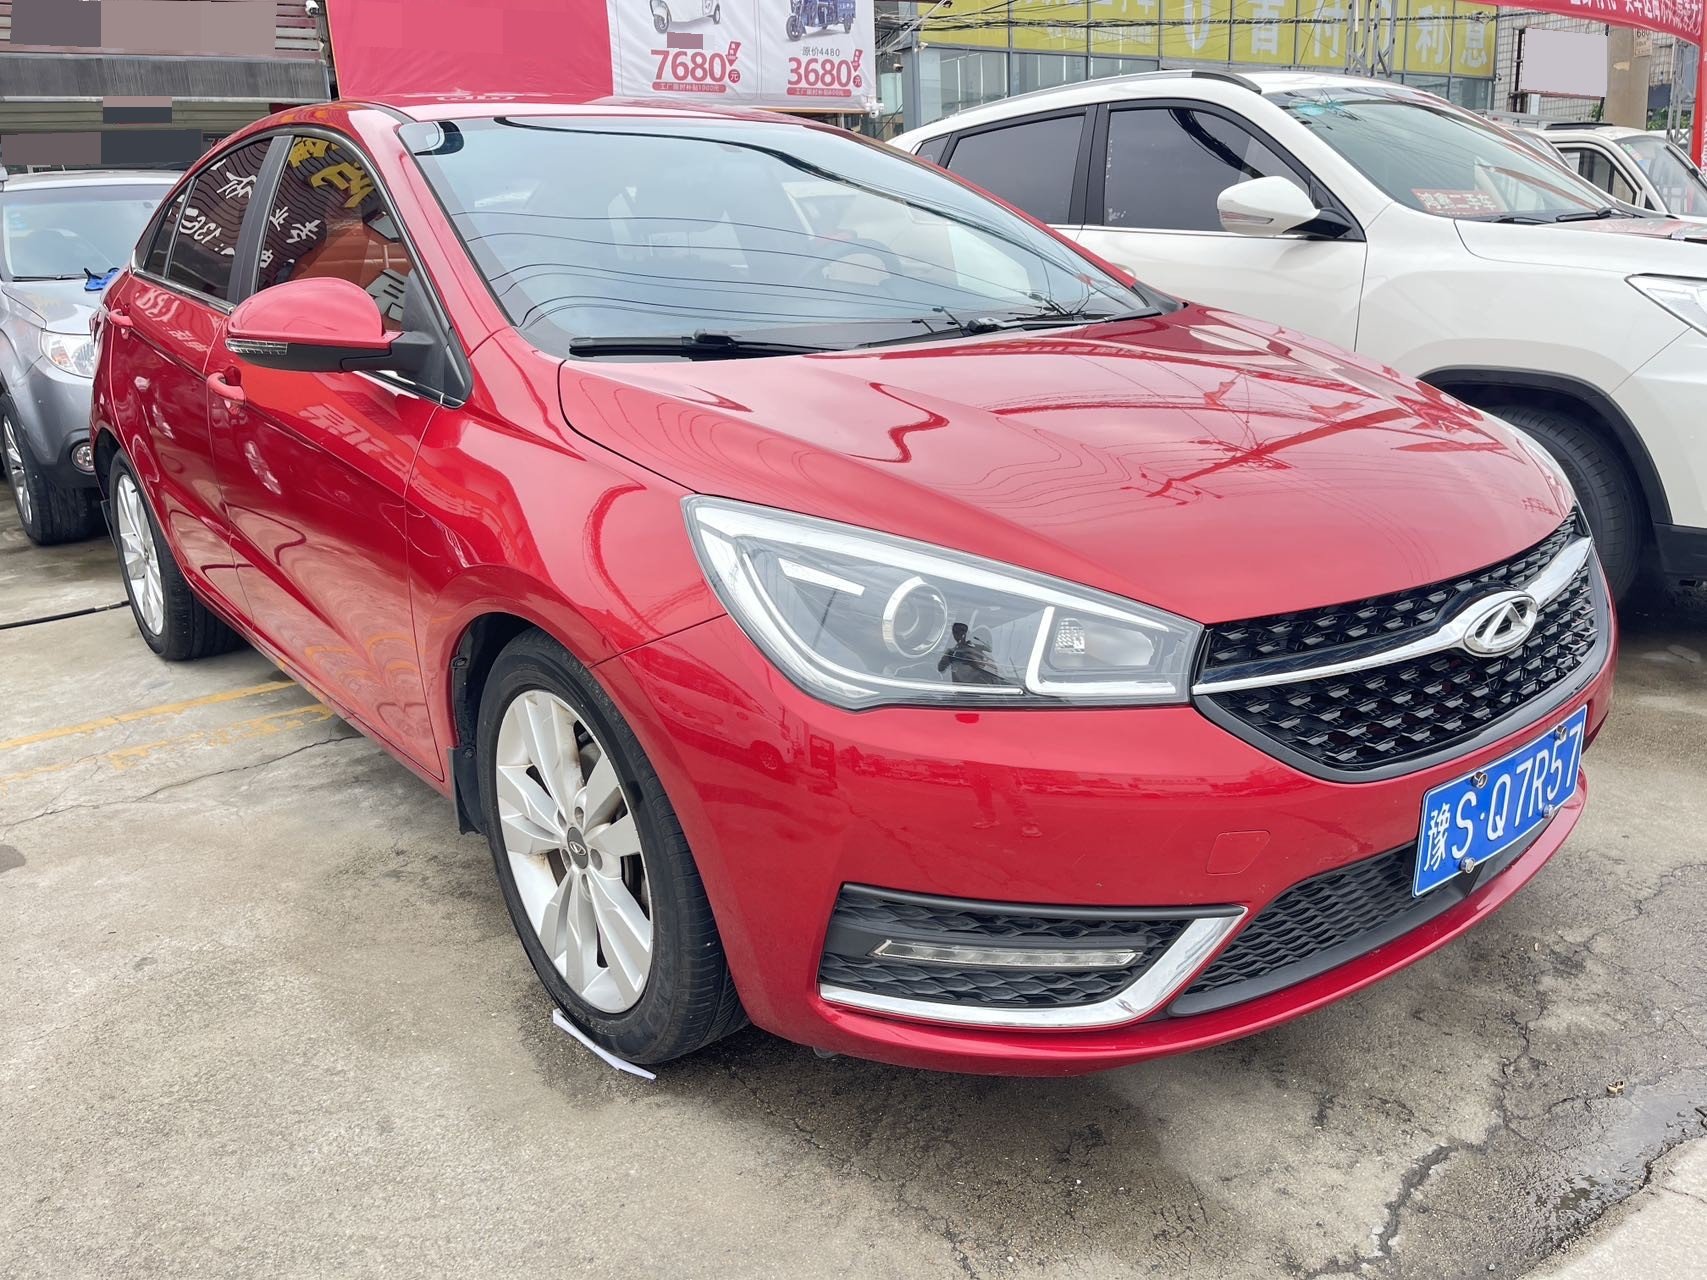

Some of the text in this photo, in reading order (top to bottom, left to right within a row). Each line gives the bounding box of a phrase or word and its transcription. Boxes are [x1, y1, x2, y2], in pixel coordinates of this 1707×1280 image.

[651, 49, 727, 82] 7680
[802, 46, 841, 57] 原价4480
[787, 57, 852, 87] 3680
